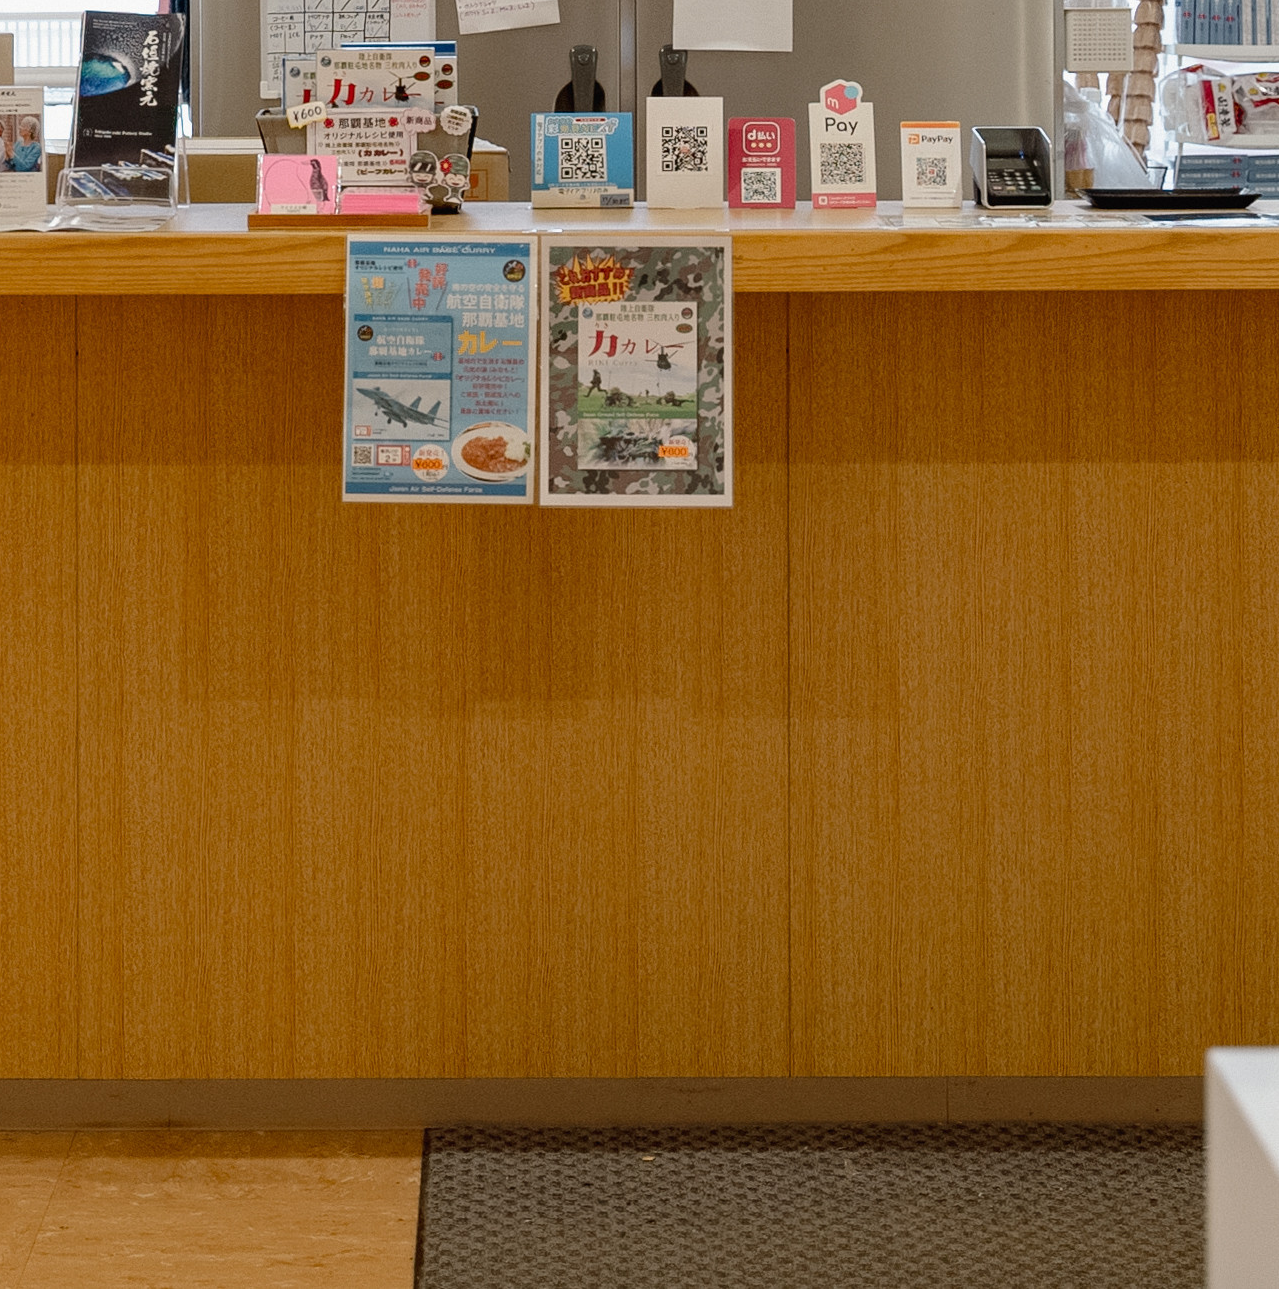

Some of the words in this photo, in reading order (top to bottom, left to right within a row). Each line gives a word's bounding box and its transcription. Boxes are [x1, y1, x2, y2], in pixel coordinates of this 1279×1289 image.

[293, 105, 322, 122] ¥600
[338, 117, 386, 129] 那覇基地
[406, 117, 433, 126] 新商品
[825, 117, 859, 136] Pay
[323, 131, 404, 140] オリジナルレシピ使用
[747, 129, 776, 141] d払い
[921, 134, 954, 145] PayPay
[383, 246, 410, 254] NAHA
[412, 246, 429, 254] AIR
[461, 246, 496, 254] CURRY
[446, 294, 525, 310] 航空自衛隊
[462, 312, 525, 328] 那覇基地
[457, 330, 523, 356] カレー
